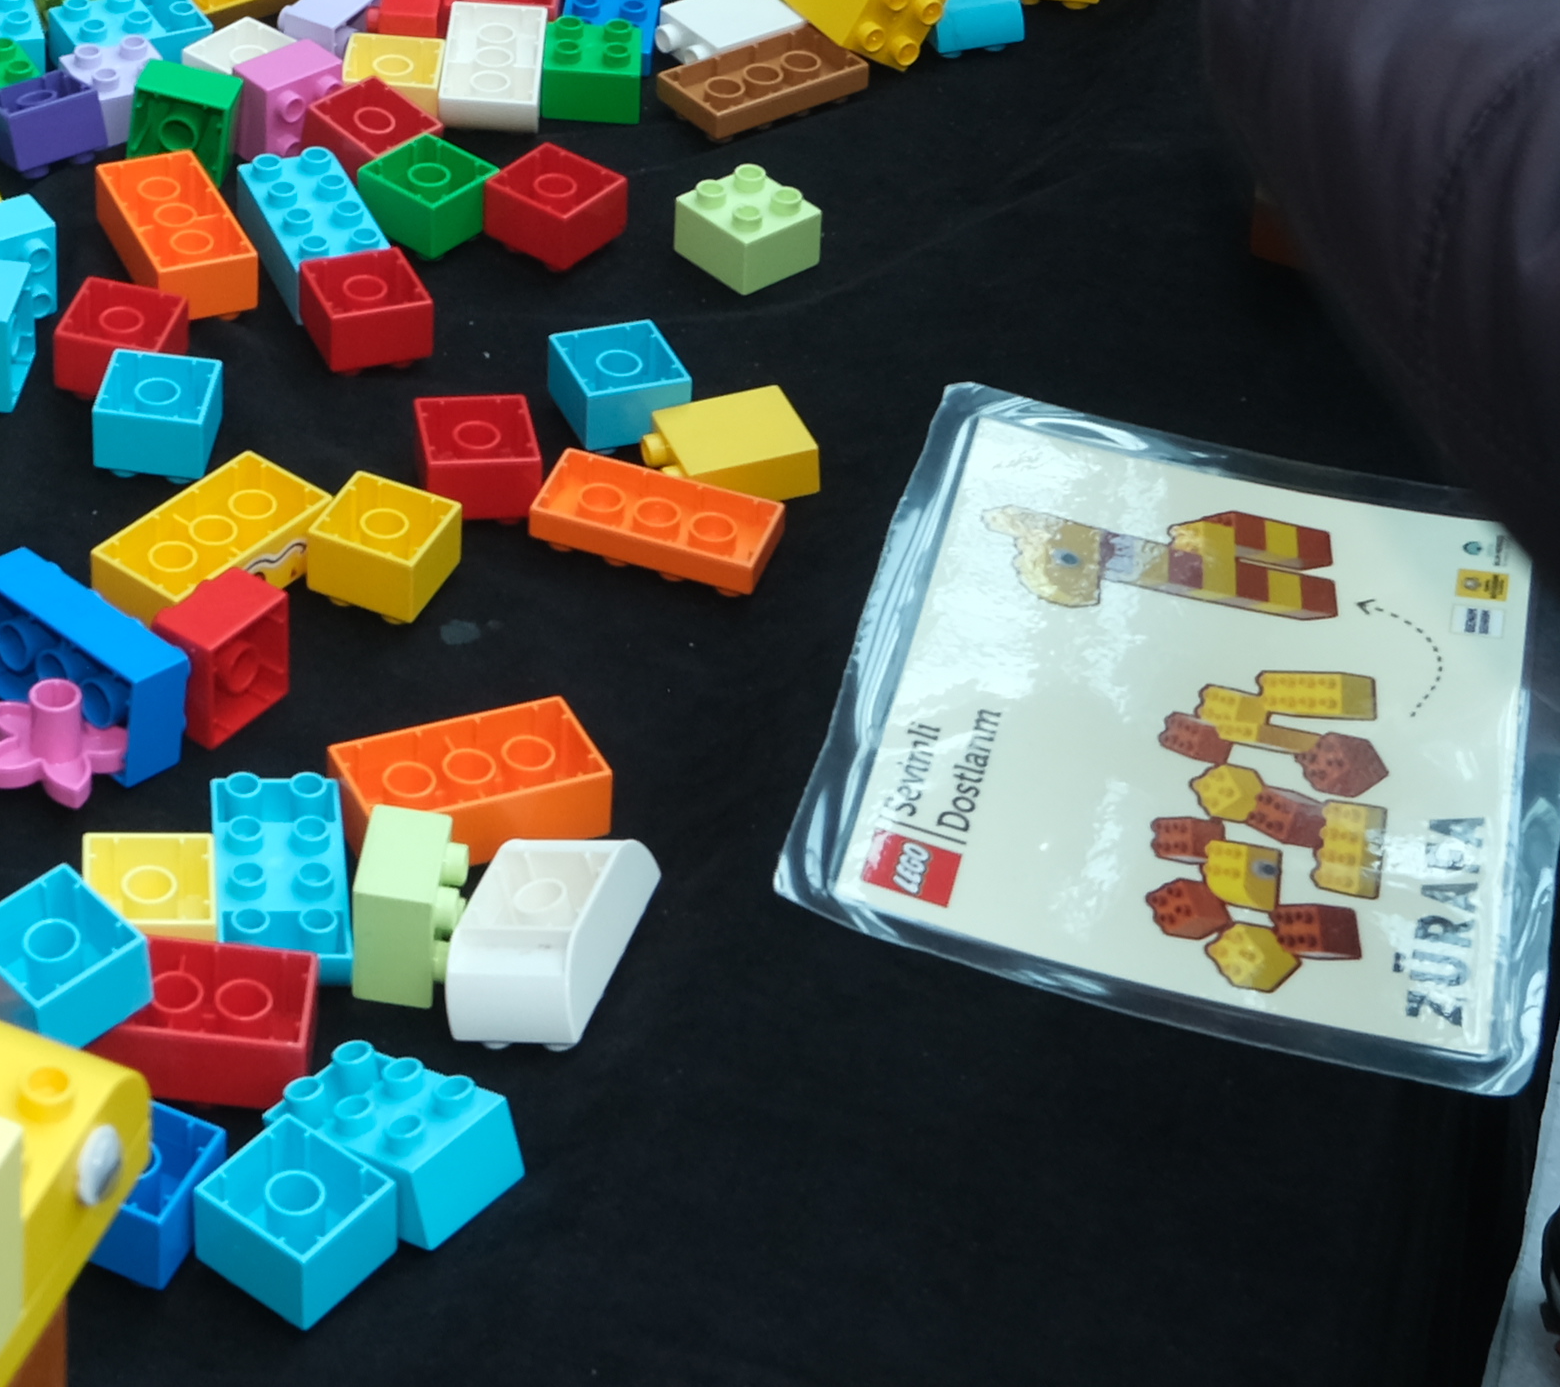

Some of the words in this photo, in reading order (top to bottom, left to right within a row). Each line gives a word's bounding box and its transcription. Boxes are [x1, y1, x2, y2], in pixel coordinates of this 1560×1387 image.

[894, 720, 943, 818] Sevimli
[936, 707, 1002, 833] Dostlarım
[892, 841, 931, 896] LEGO
[1392, 817, 1485, 1028] ZÜRAFA
